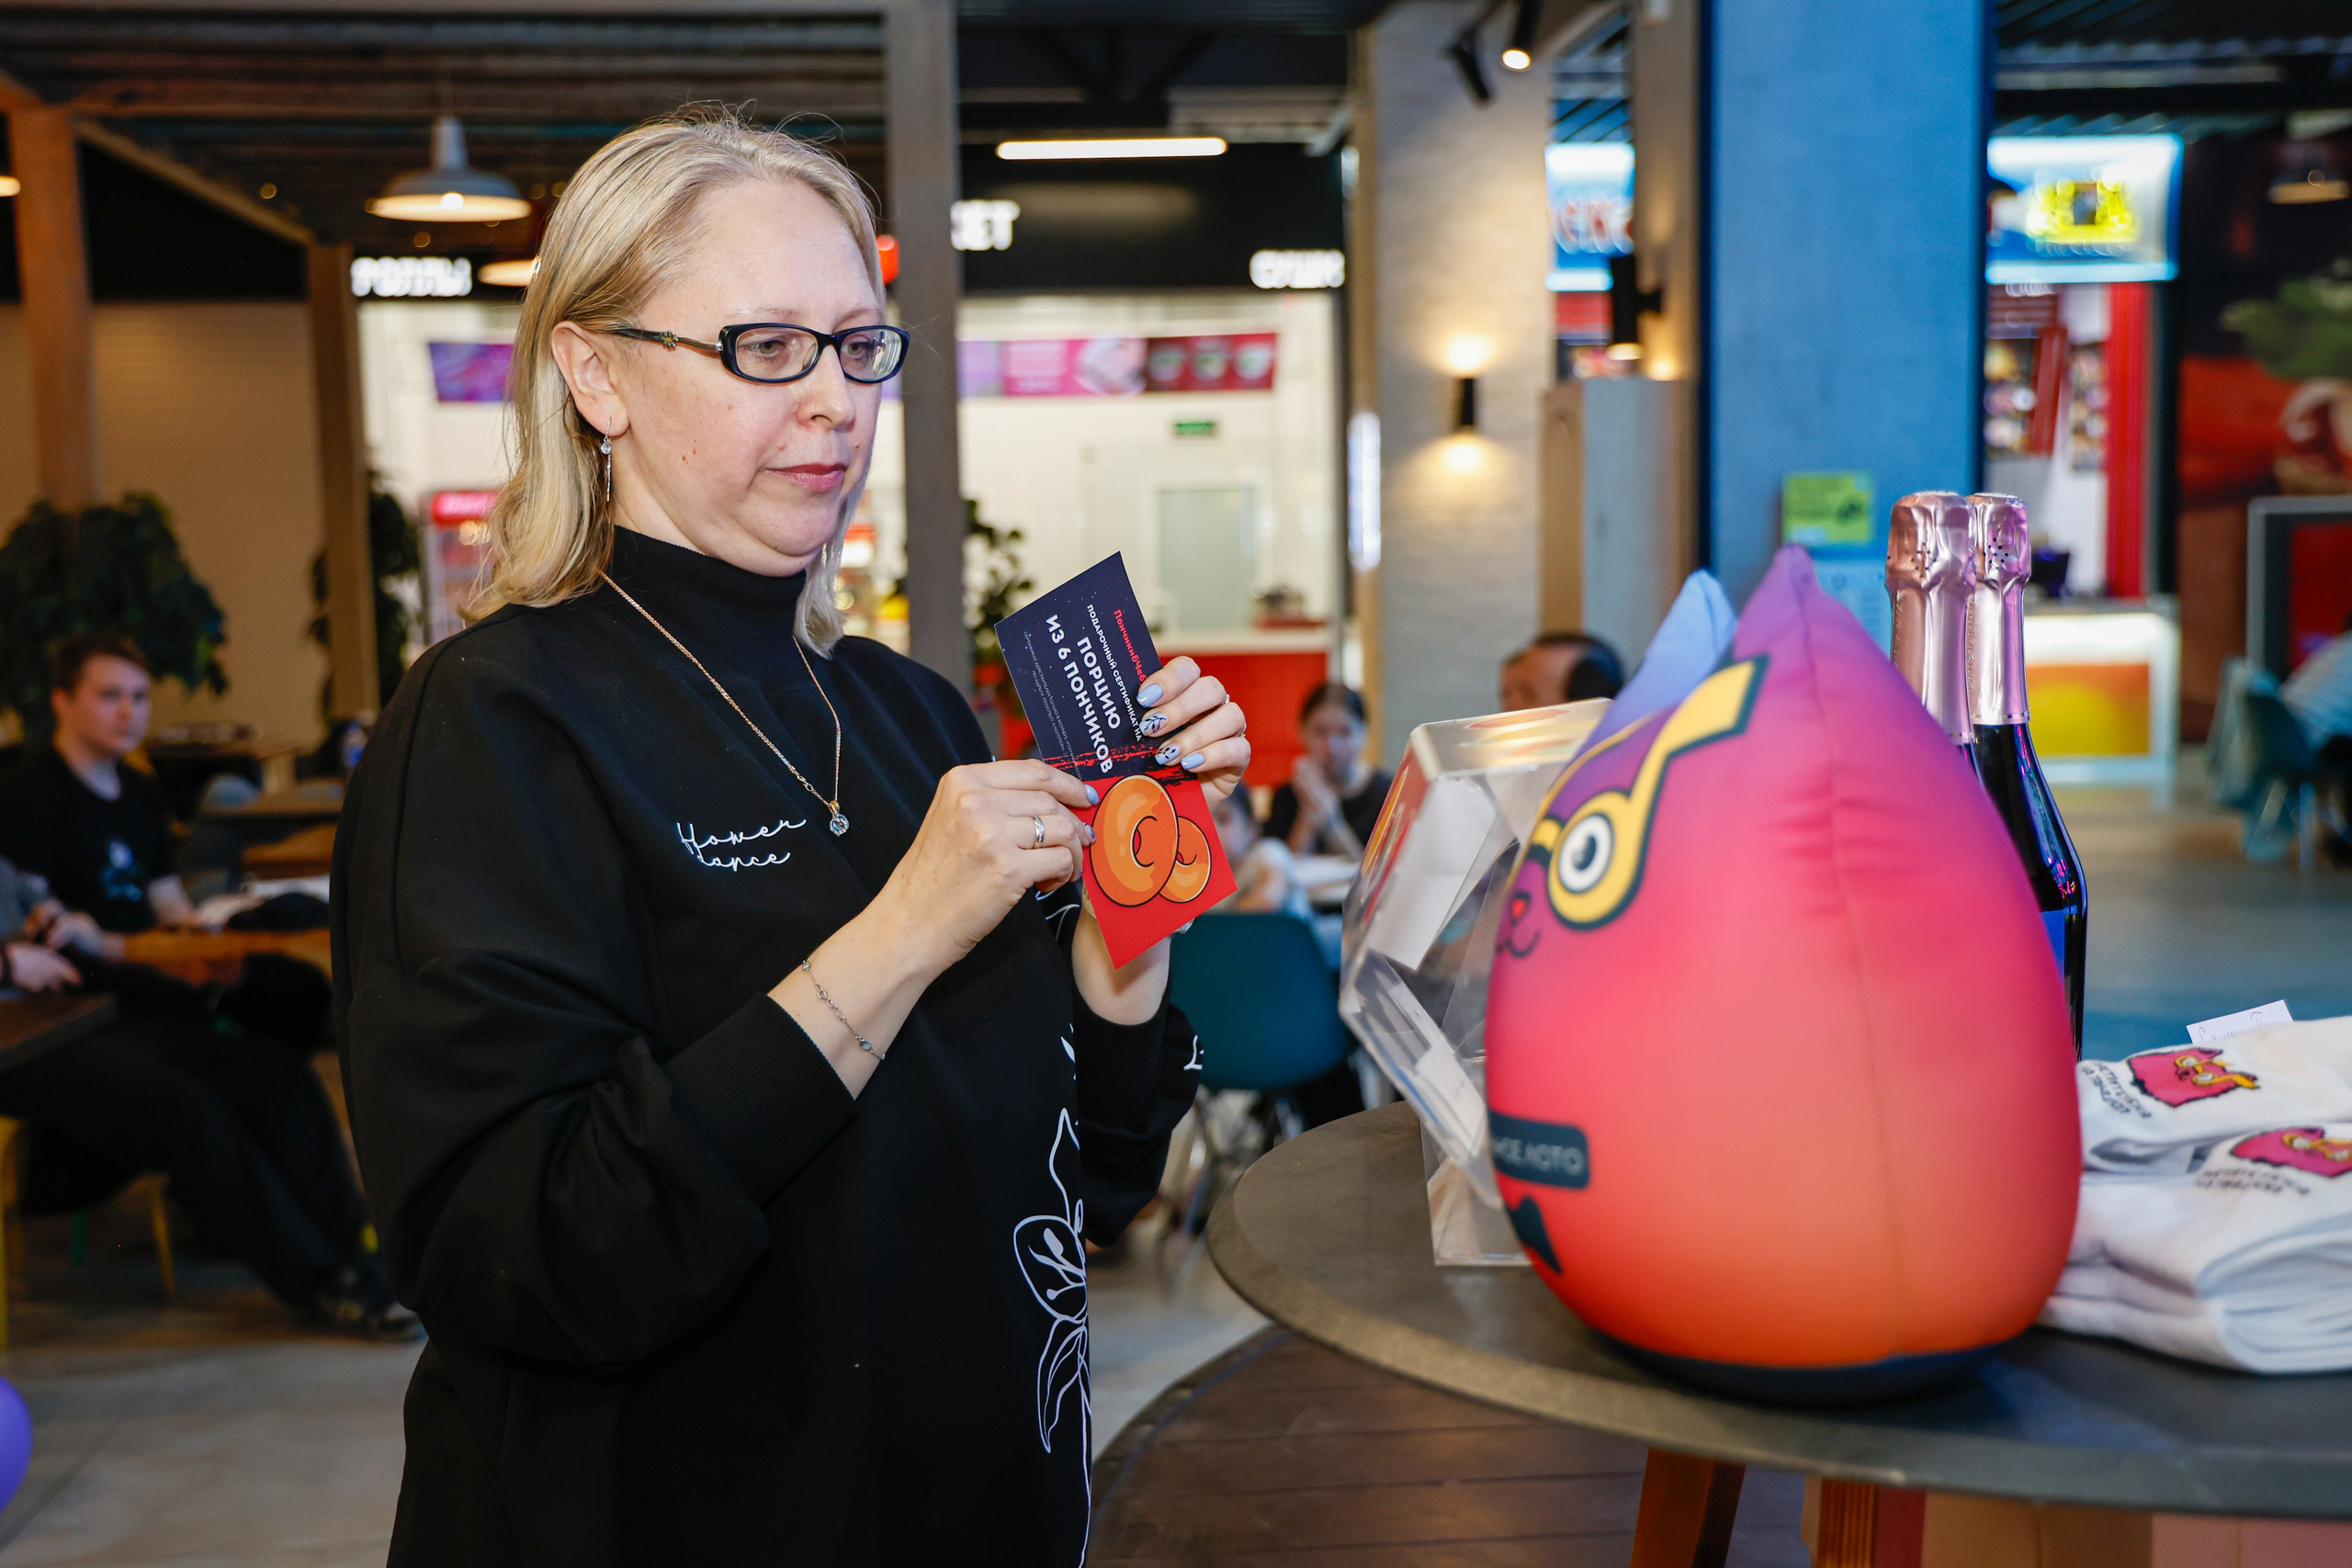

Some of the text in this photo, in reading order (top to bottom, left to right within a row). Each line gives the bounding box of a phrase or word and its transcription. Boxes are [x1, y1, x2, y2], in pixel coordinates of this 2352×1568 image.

[1046, 614, 1114, 773] ИЗ 6 ПОНЧИКОВ
[1077, 636, 1122, 729] ПОРЦИЮ
[1086, 604, 1143, 742] ПОДАРОЧНЫЙ СЕРТИФИКАТ НА
[1114, 609, 1146, 685] Пончики&Чеб
[1524, 1142, 1584, 1177] ЛОТО
